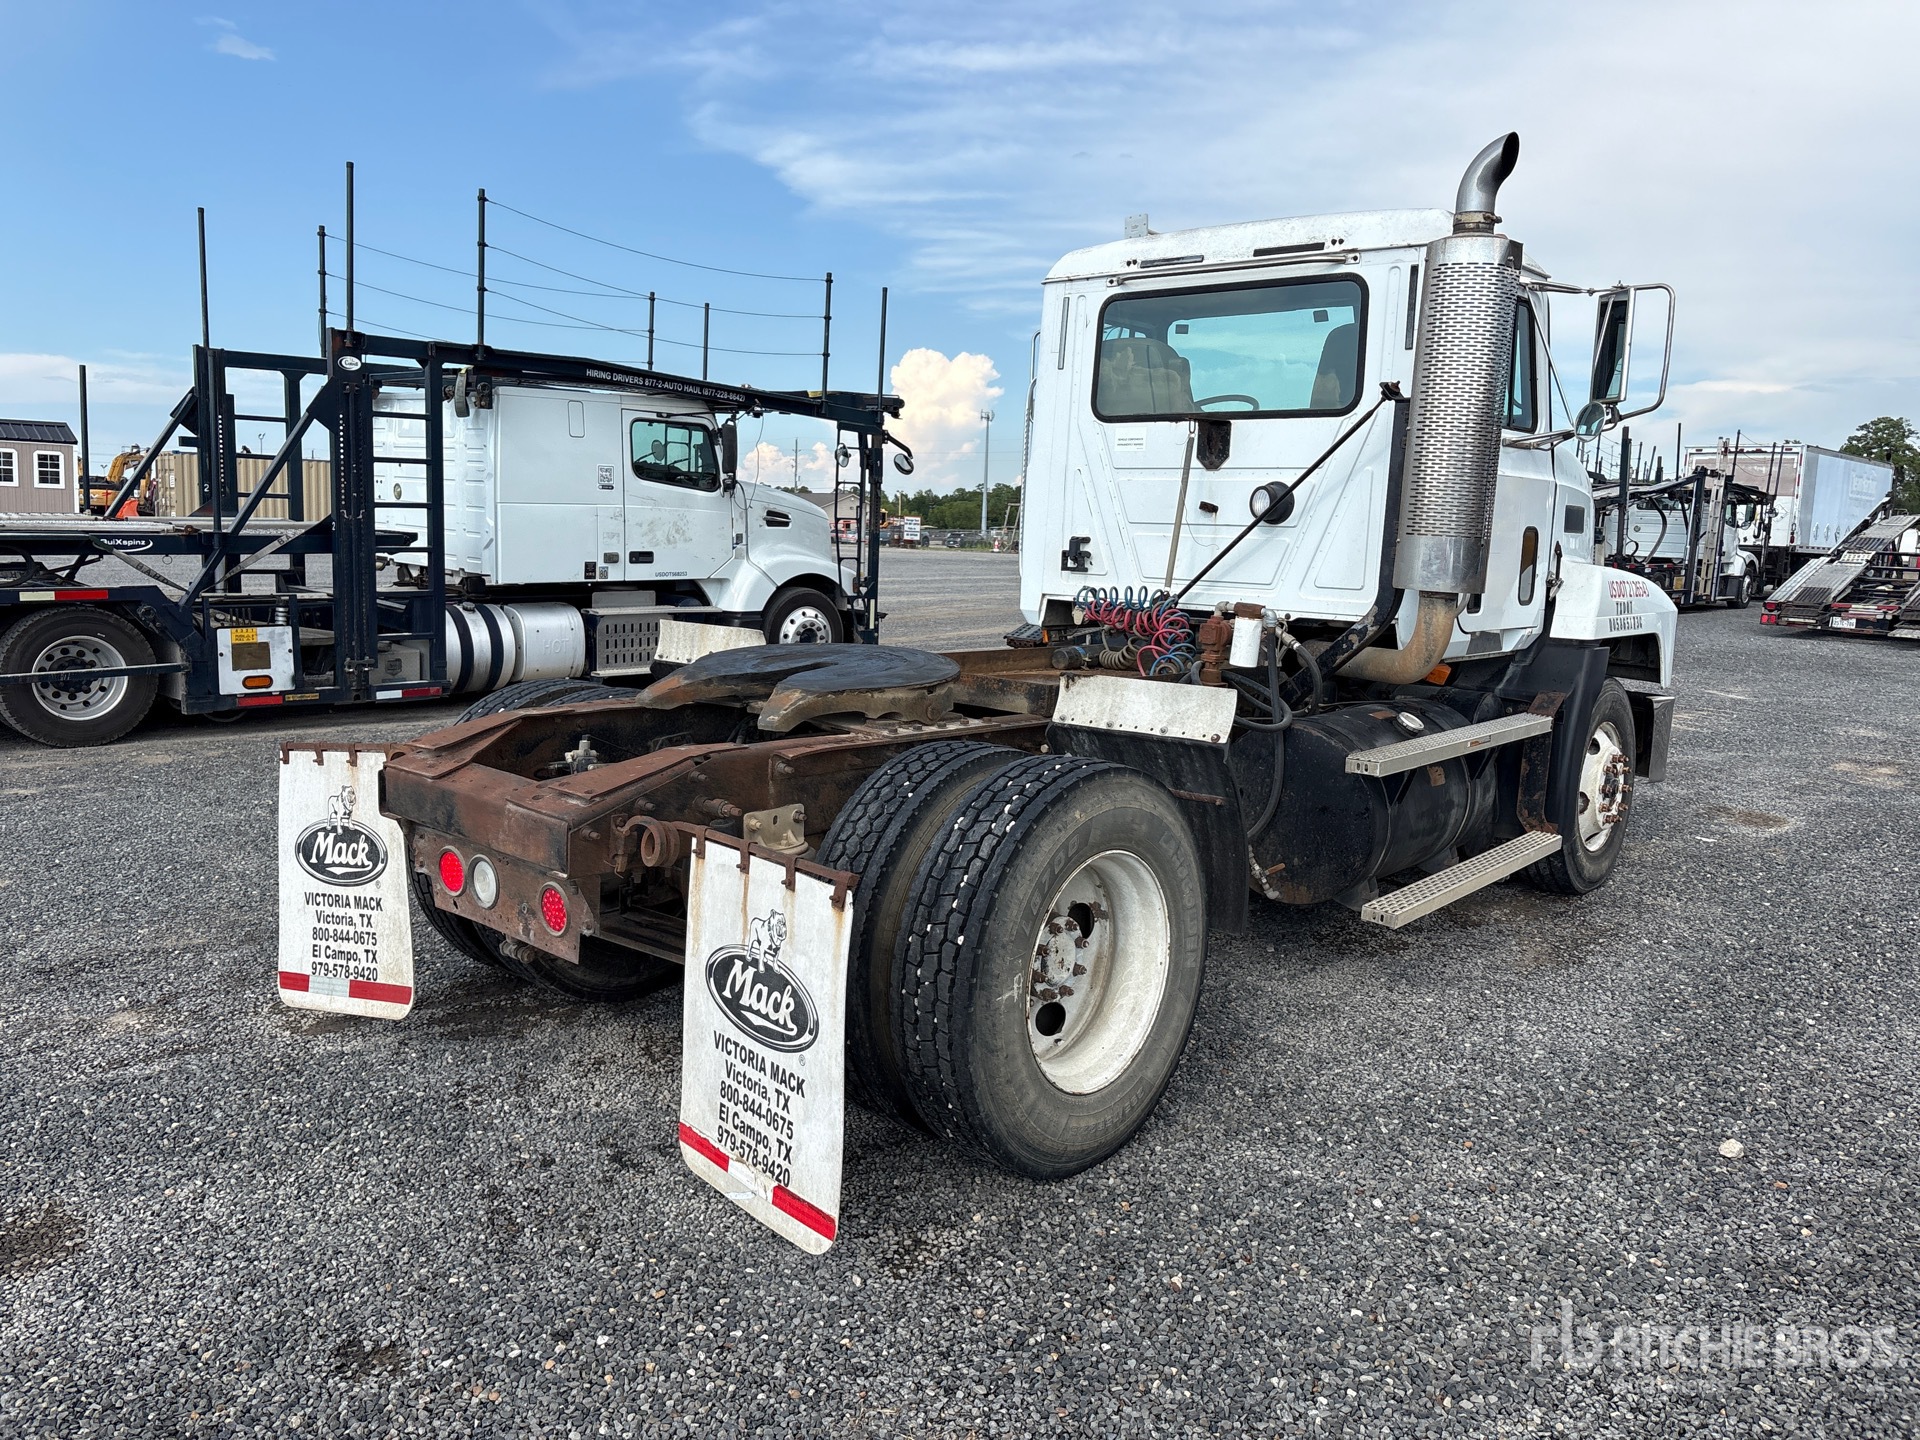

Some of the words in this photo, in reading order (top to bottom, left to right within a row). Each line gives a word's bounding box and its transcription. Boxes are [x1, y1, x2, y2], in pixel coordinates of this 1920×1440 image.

[586, 368, 612, 380] HIRING
[612, 373, 644, 385] DRIVERS
[644, 378, 683, 391] 877-2-AUTO
[683, 384, 702, 395] HAUL
[204, 484, 210, 492] 2
[332, 521, 337, 531] 2
[543, 638, 569, 655] HOT
[310, 831, 373, 869] Mack
[304, 891, 351, 909] VICTORIA
[354, 895, 384, 912] MACK
[315, 909, 357, 930] Victoria,
[359, 913, 373, 929] TX
[312, 926, 377, 946] 800-844-0675
[312, 944, 321, 958] El
[324, 945, 361, 965] Campo,
[364, 949, 378, 964] TX
[311, 961, 378, 982] 979-578-9420
[722, 958, 797, 1033] Mack
[713, 1029, 767, 1077] VICTORIA
[770, 1060, 806, 1099] MACK
[725, 1058, 771, 1107] Victoria,
[774, 1087, 791, 1115] TX
[719, 1080, 794, 1141] 800-844-0675
[718, 1101, 729, 1124] El
[732, 1110, 772, 1157] Campo,
[776, 1137, 792, 1166] TX
[717, 1124, 791, 1188] 979-578-9420
